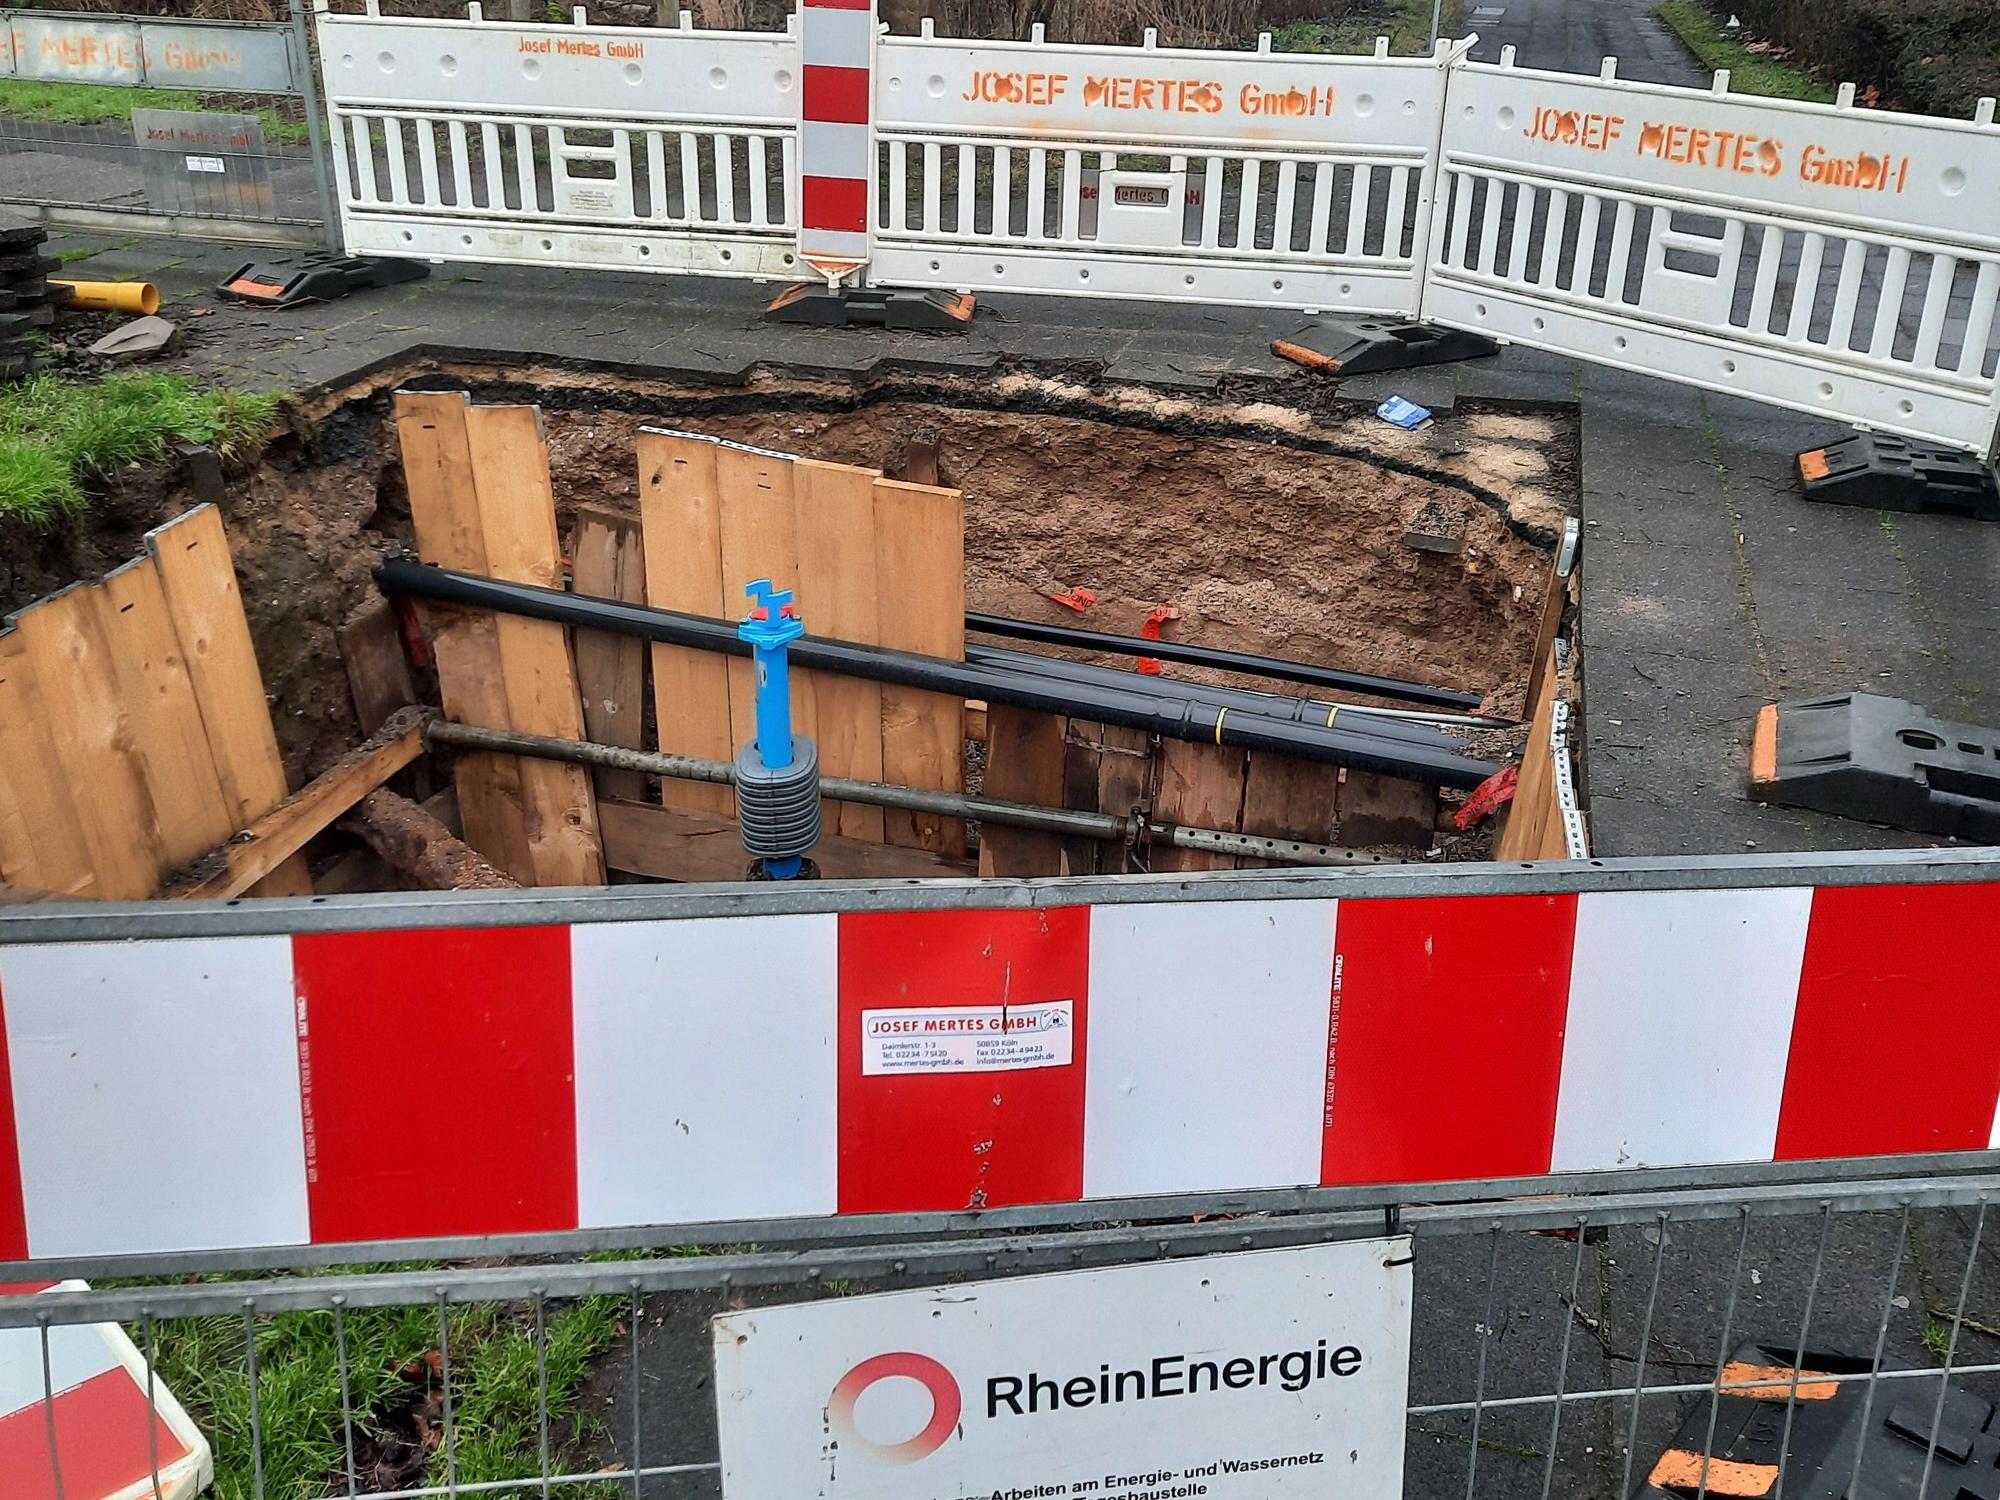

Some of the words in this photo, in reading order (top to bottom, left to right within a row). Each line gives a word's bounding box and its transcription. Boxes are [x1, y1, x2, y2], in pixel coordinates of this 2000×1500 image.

[518, 36, 551, 53] Josef
[557, 39, 601, 57] Mertes
[607, 41, 644, 58] GmbH
[962, 71, 1068, 104] JOSEF
[1083, 75, 1223, 113] MERTES
[1240, 83, 1337, 116] GmbH
[1523, 106, 1625, 151] JOSEF
[1637, 121, 1783, 177] MERTES
[1801, 144, 1909, 193] GmbH
[872, 1020, 919, 1033] JOSEF
[925, 1019, 985, 1031] MERTES
[989, 1016, 1037, 1030] GMBH
[1001, 1039, 1018, 1047] Köln
[986, 1339, 1362, 1419] RheinEnergie
[991, 1484, 1067, 1500] Arbeiten
[1072, 1480, 1099, 1493] am
[1105, 1469, 1179, 1489] Energie-
[1184, 1462, 1217, 1479] und
[1221, 1452, 1325, 1474] Wassernetz
